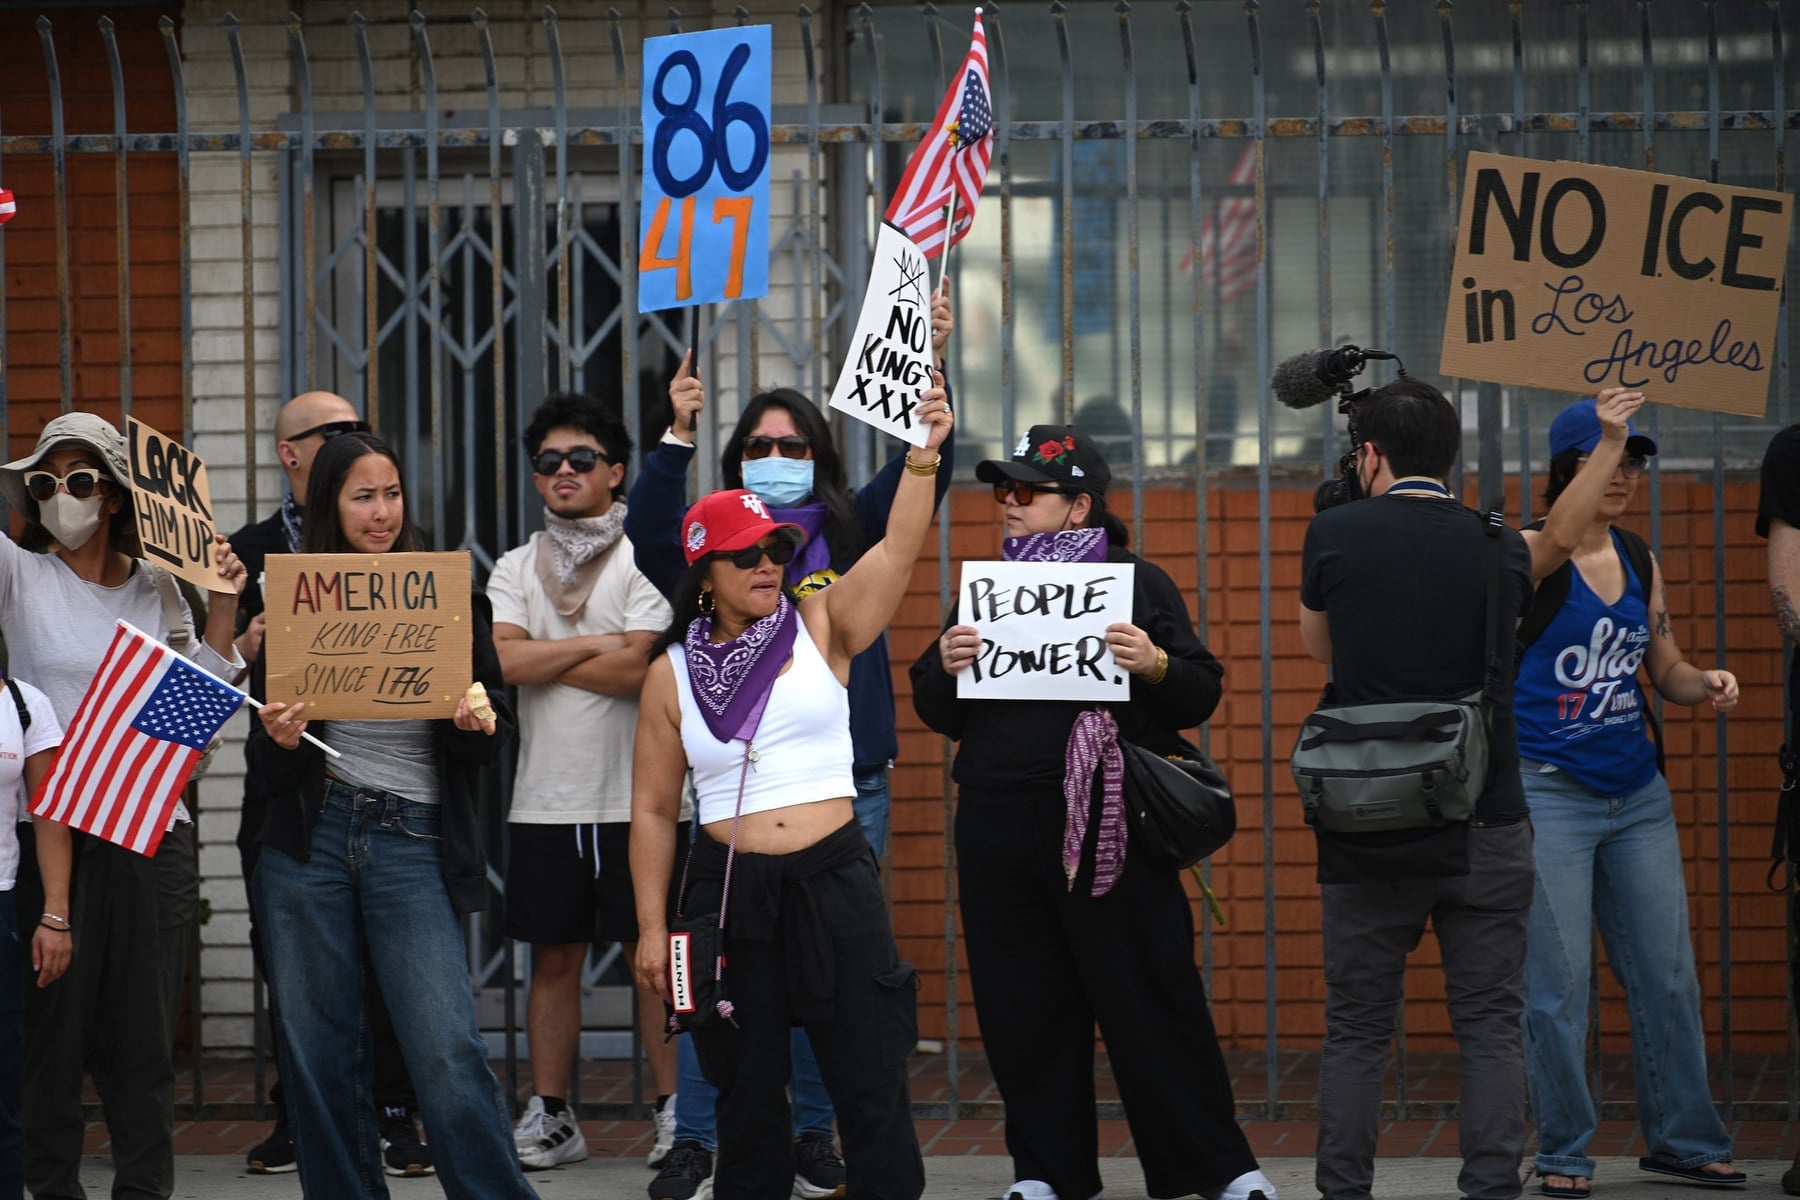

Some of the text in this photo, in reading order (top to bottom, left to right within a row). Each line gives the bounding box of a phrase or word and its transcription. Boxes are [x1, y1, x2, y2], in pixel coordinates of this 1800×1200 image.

[653, 42, 769, 199] 86
[638, 195, 753, 301] 47
[1468, 168, 1607, 269] NO
[885, 304, 927, 354] NO
[1462, 274, 1635, 344] in Los
[1583, 318, 1765, 389] Angeles
[128, 420, 214, 522] LOCK
[134, 491, 214, 569] HIM UP
[291, 570, 438, 616] AMERICA
[968, 575, 1117, 623] PEOPLE
[310, 621, 445, 651] KING-FREE
[295, 662, 435, 699] SINCE 1776
[1556, 692, 1588, 720] 17
[674, 940, 685, 1006] HUNTER
